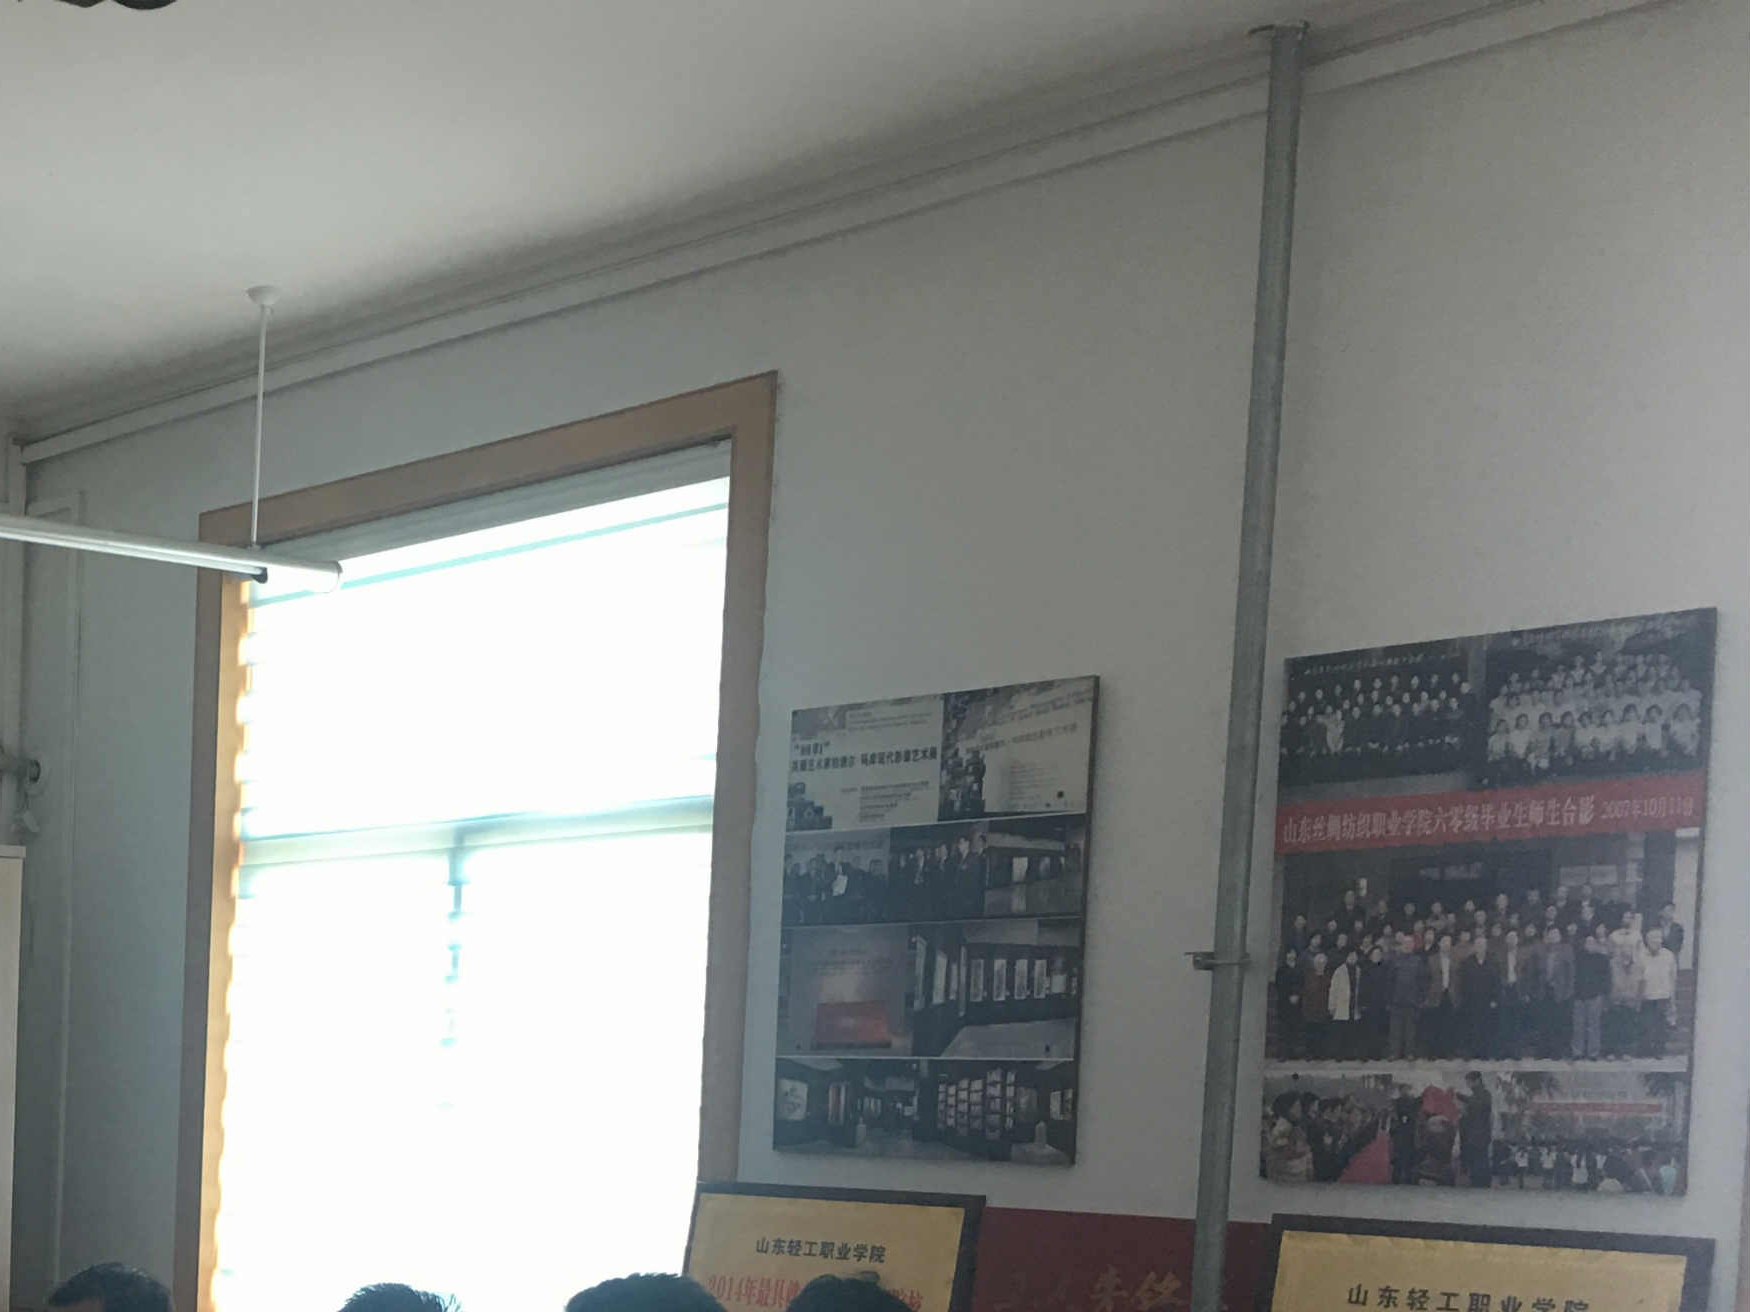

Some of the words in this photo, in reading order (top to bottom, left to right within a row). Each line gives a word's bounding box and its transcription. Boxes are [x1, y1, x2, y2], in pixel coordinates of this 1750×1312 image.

[755, 1236, 886, 1264] 山东轻工职业学院
